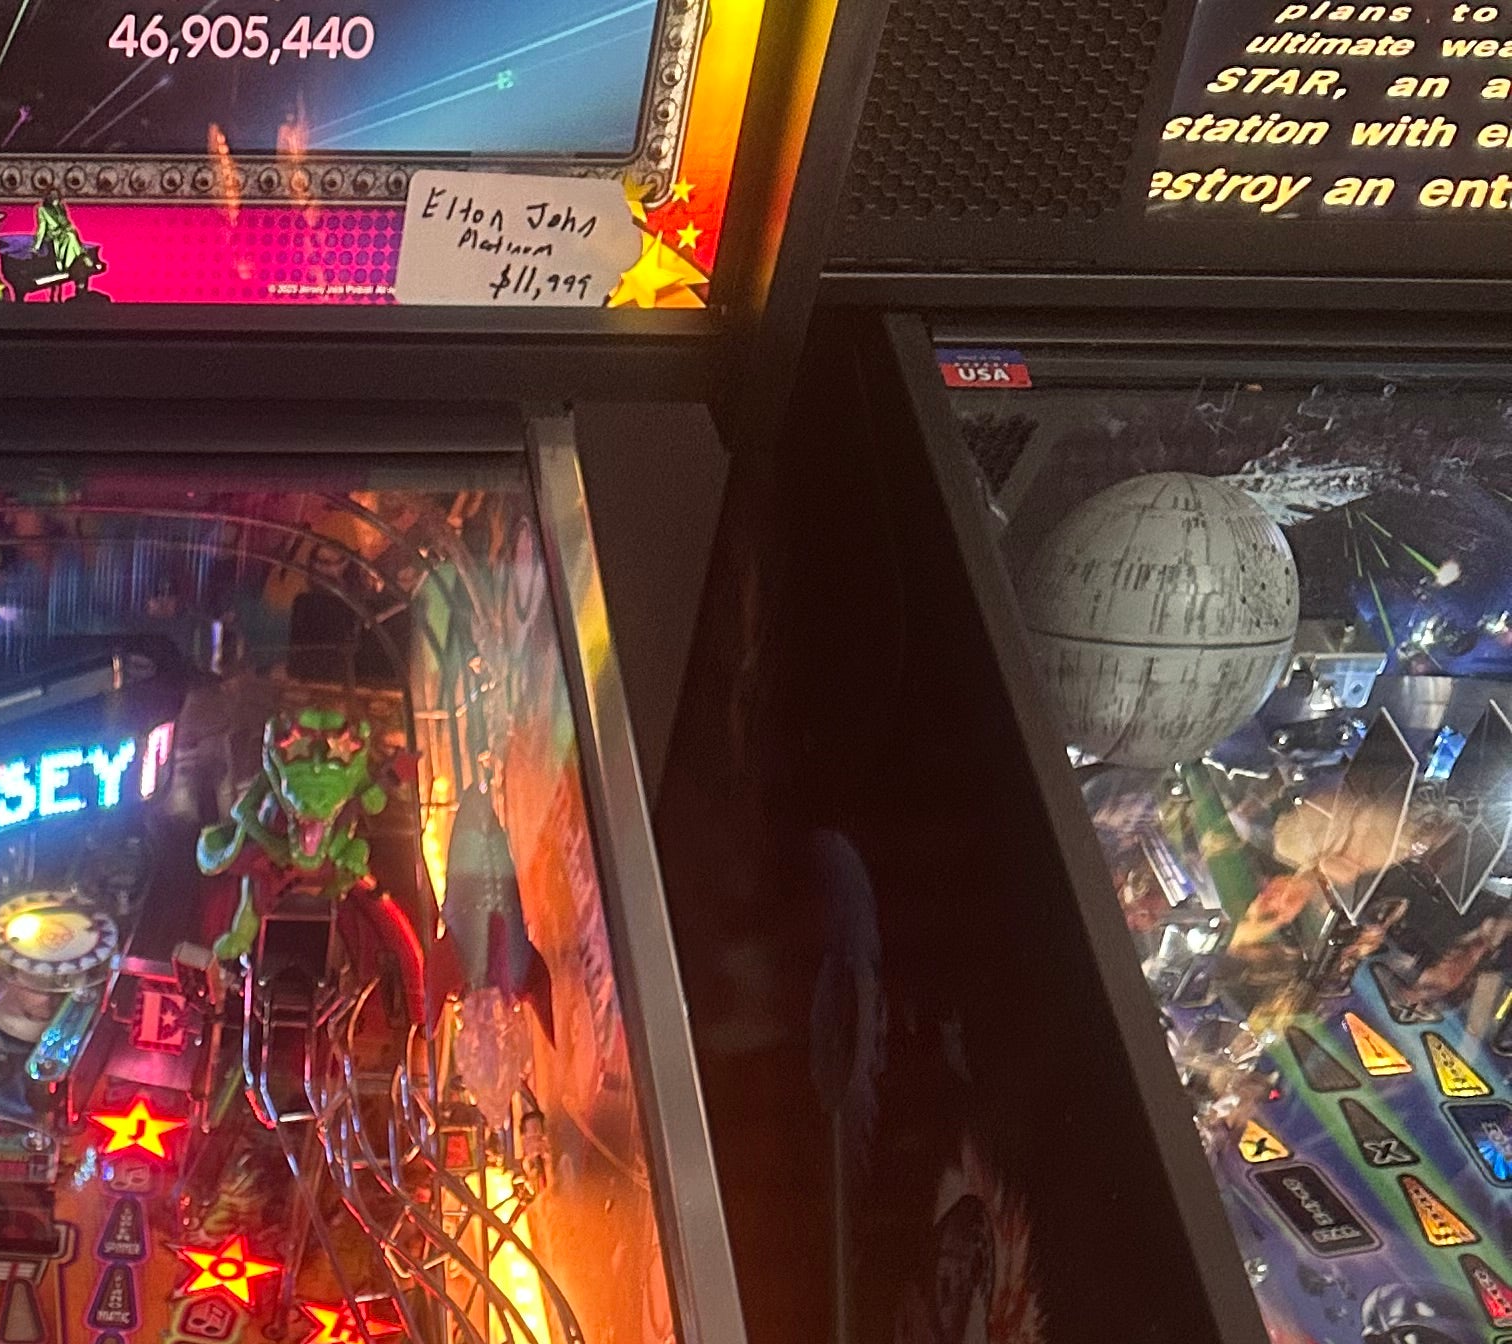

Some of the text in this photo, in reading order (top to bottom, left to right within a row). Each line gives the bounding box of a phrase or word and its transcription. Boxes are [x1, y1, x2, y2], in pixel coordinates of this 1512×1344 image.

[1275, 1, 1499, 25] plans to
[108, 14, 375, 64] 46,905,440
[1245, 32, 1416, 58] ultimate
[1206, 67, 1348, 100] STAR,
[1387, 76, 1451, 98] an
[1161, 113, 1330, 145] station
[1351, 116, 1458, 148] with
[1322, 176, 1396, 207] an
[422, 186, 597, 238] Elton John
[457, 228, 553, 256] Platinum
[489, 264, 592, 301] $11,999
[958, 367, 1010, 381] USA
[213, 1256, 243, 1281] O
